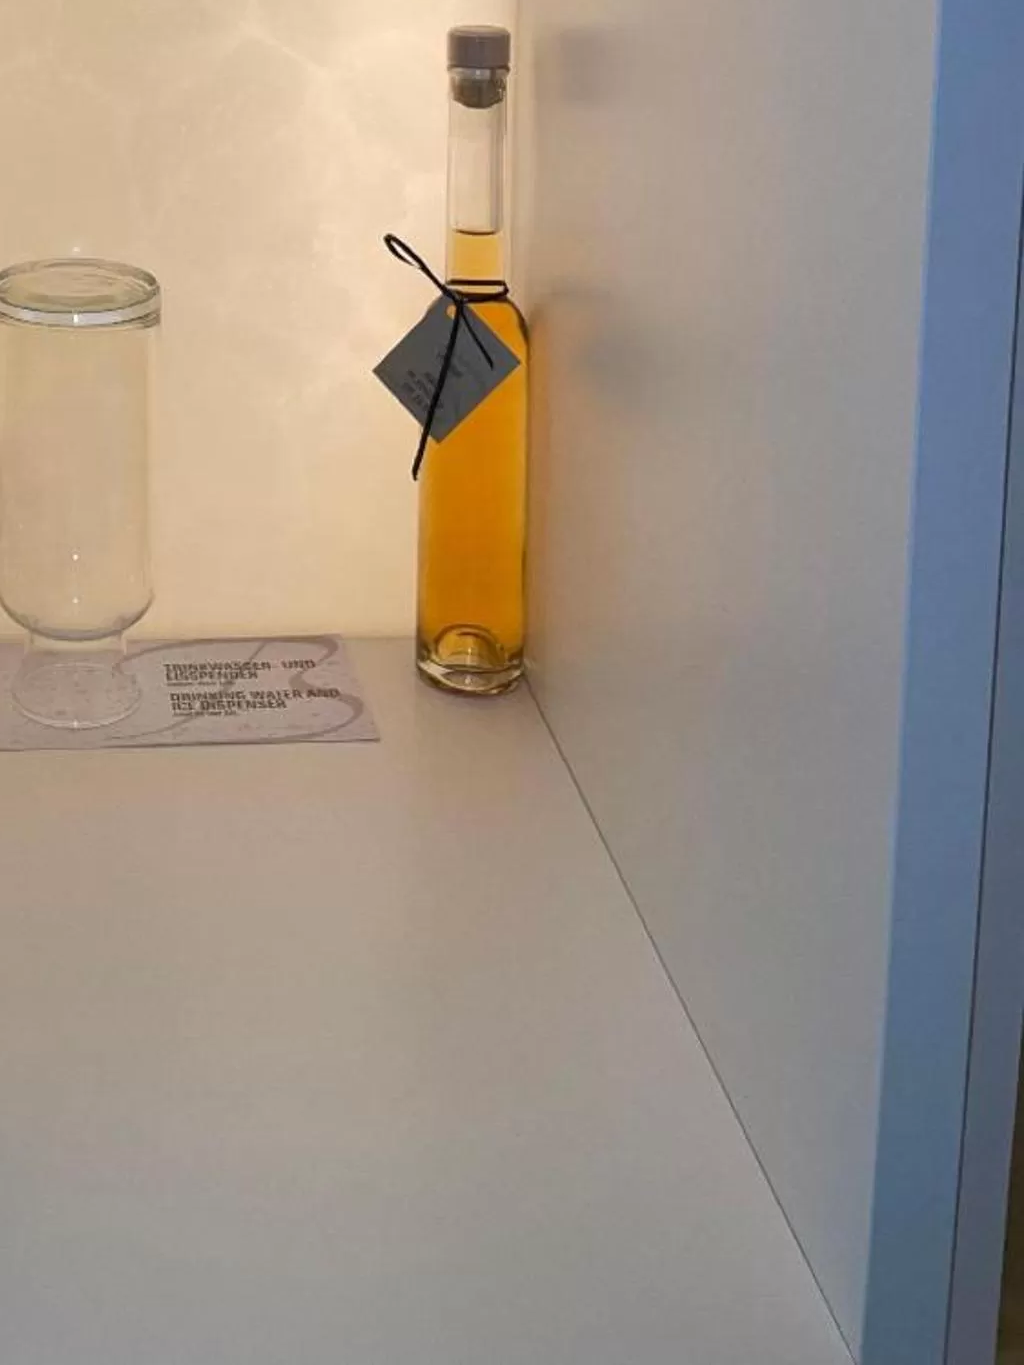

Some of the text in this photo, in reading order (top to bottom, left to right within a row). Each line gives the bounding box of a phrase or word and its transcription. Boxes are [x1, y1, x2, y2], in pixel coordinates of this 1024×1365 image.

[281, 659, 316, 670] UND
[169, 687, 341, 702] DRINKING WATER AND
[200, 699, 288, 711] DISPENSER
